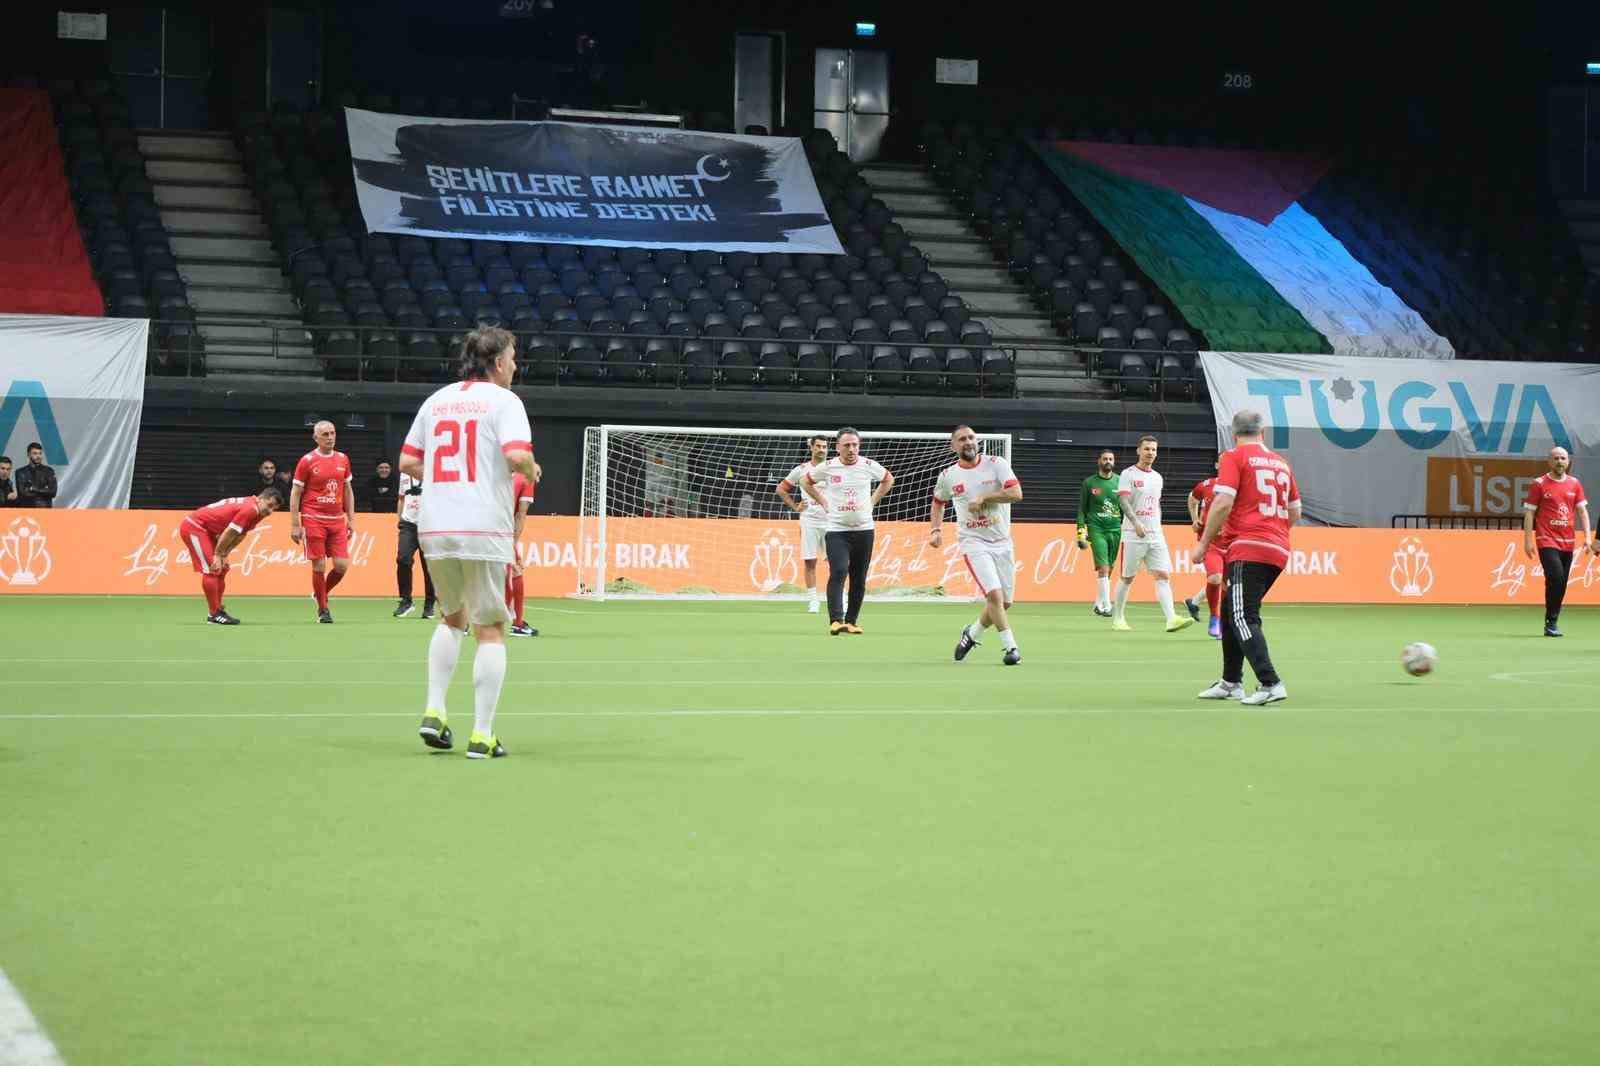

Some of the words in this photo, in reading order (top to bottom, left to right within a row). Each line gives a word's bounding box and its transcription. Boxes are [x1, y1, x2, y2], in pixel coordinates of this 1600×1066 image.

[1224, 73, 1252, 88] 208
[426, 165, 588, 196] ŞEHİTLERE
[590, 174, 709, 198] RAHMET
[439, 194, 588, 218] FİLİSTİNE
[590, 202, 717, 221] DESTEK!
[433, 419, 477, 483] 21
[1255, 470, 1290, 519] 53
[615, 541, 691, 569] BIRAK
